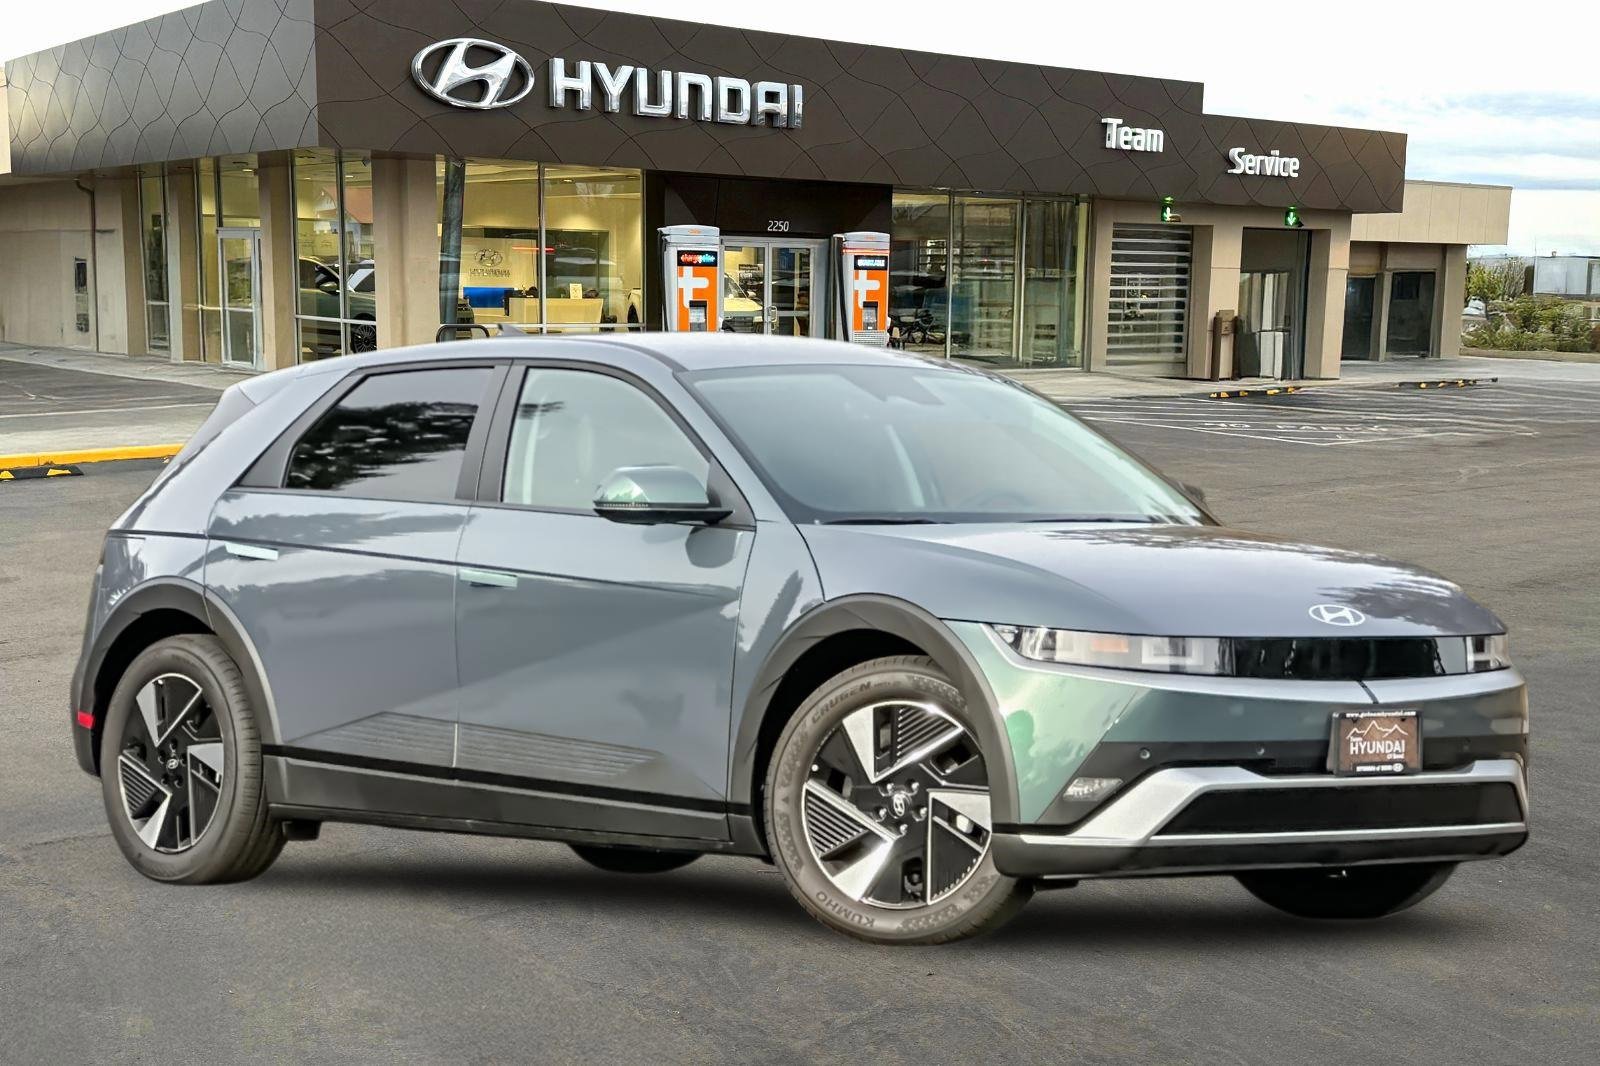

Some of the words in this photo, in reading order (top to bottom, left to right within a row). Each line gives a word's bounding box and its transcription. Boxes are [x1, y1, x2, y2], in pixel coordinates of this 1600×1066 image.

[549, 57, 803, 129] HYUNDAI
[1101, 117, 1164, 152] Team
[1227, 147, 1300, 178] Service
[767, 220, 789, 231] 2250
[1350, 740, 1405, 754] HYUNDAI
[816, 891, 876, 927] KUMHO
